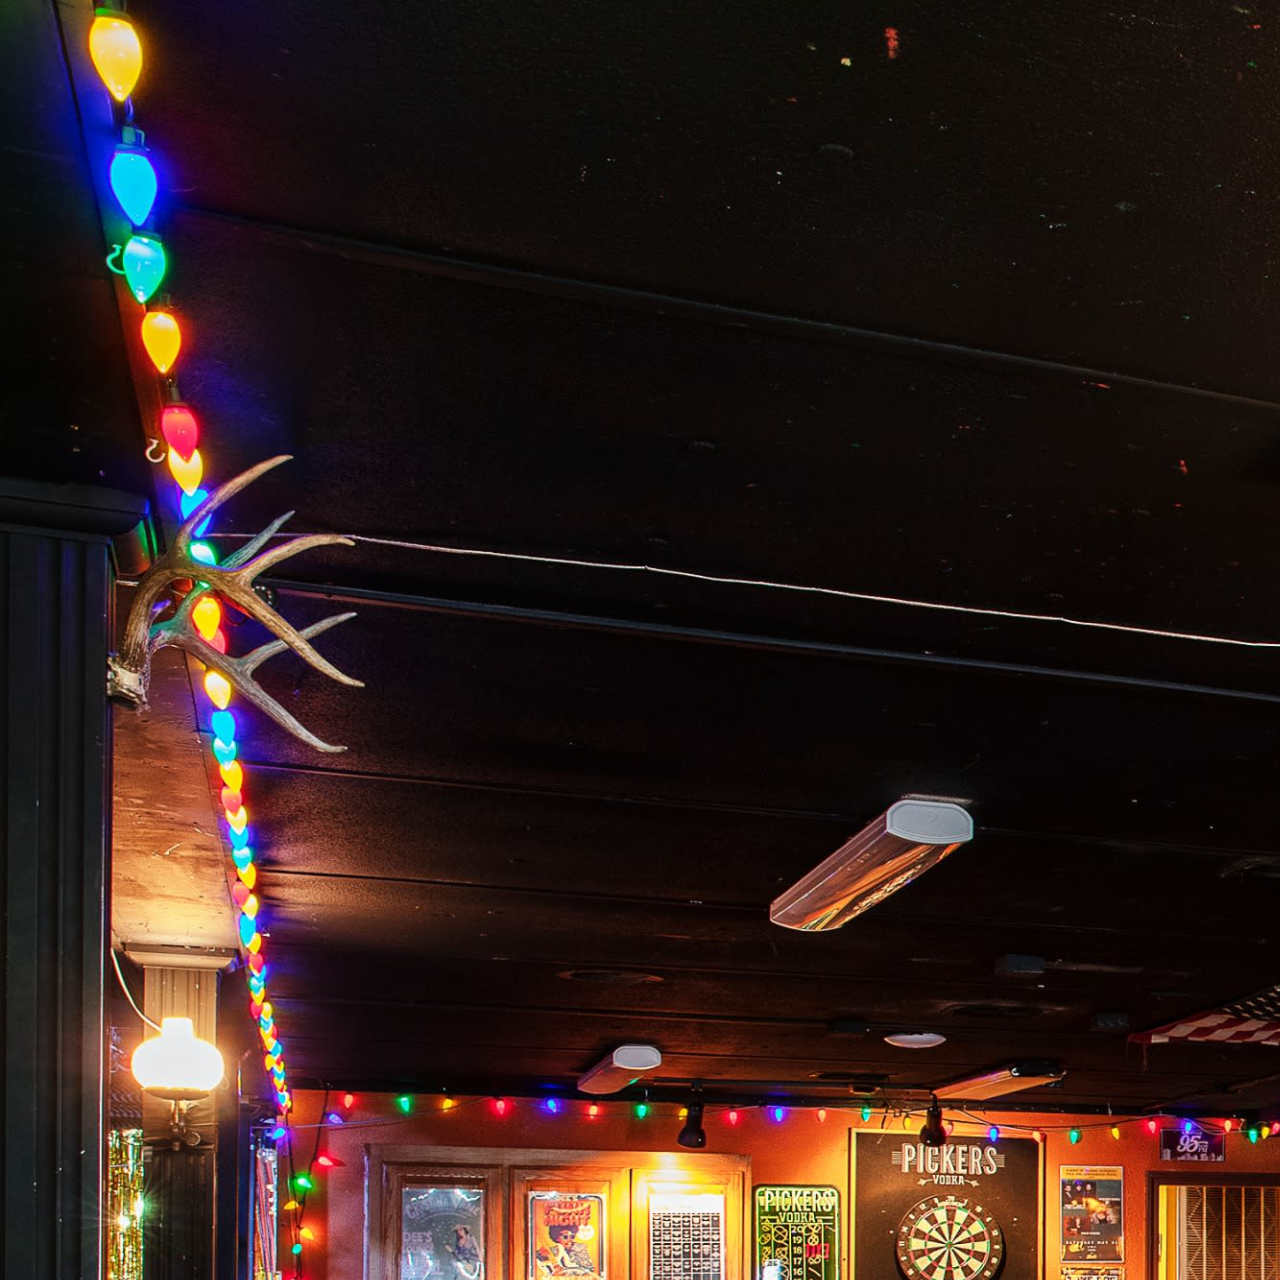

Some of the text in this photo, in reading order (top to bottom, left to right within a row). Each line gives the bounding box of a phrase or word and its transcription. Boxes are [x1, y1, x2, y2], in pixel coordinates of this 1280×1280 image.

[1177, 1135, 1202, 1152] 95
[901, 1143, 998, 1175] PICKERS
[933, 1175, 965, 1185] VODKA
[765, 1190, 832, 1212] PICKERS
[778, 1212, 816, 1223] VODKA
[793, 1236, 802, 1244] 19
[793, 1246, 802, 1254] 18
[793, 1257, 802, 1265] 17
[793, 1268, 802, 1276] 16
